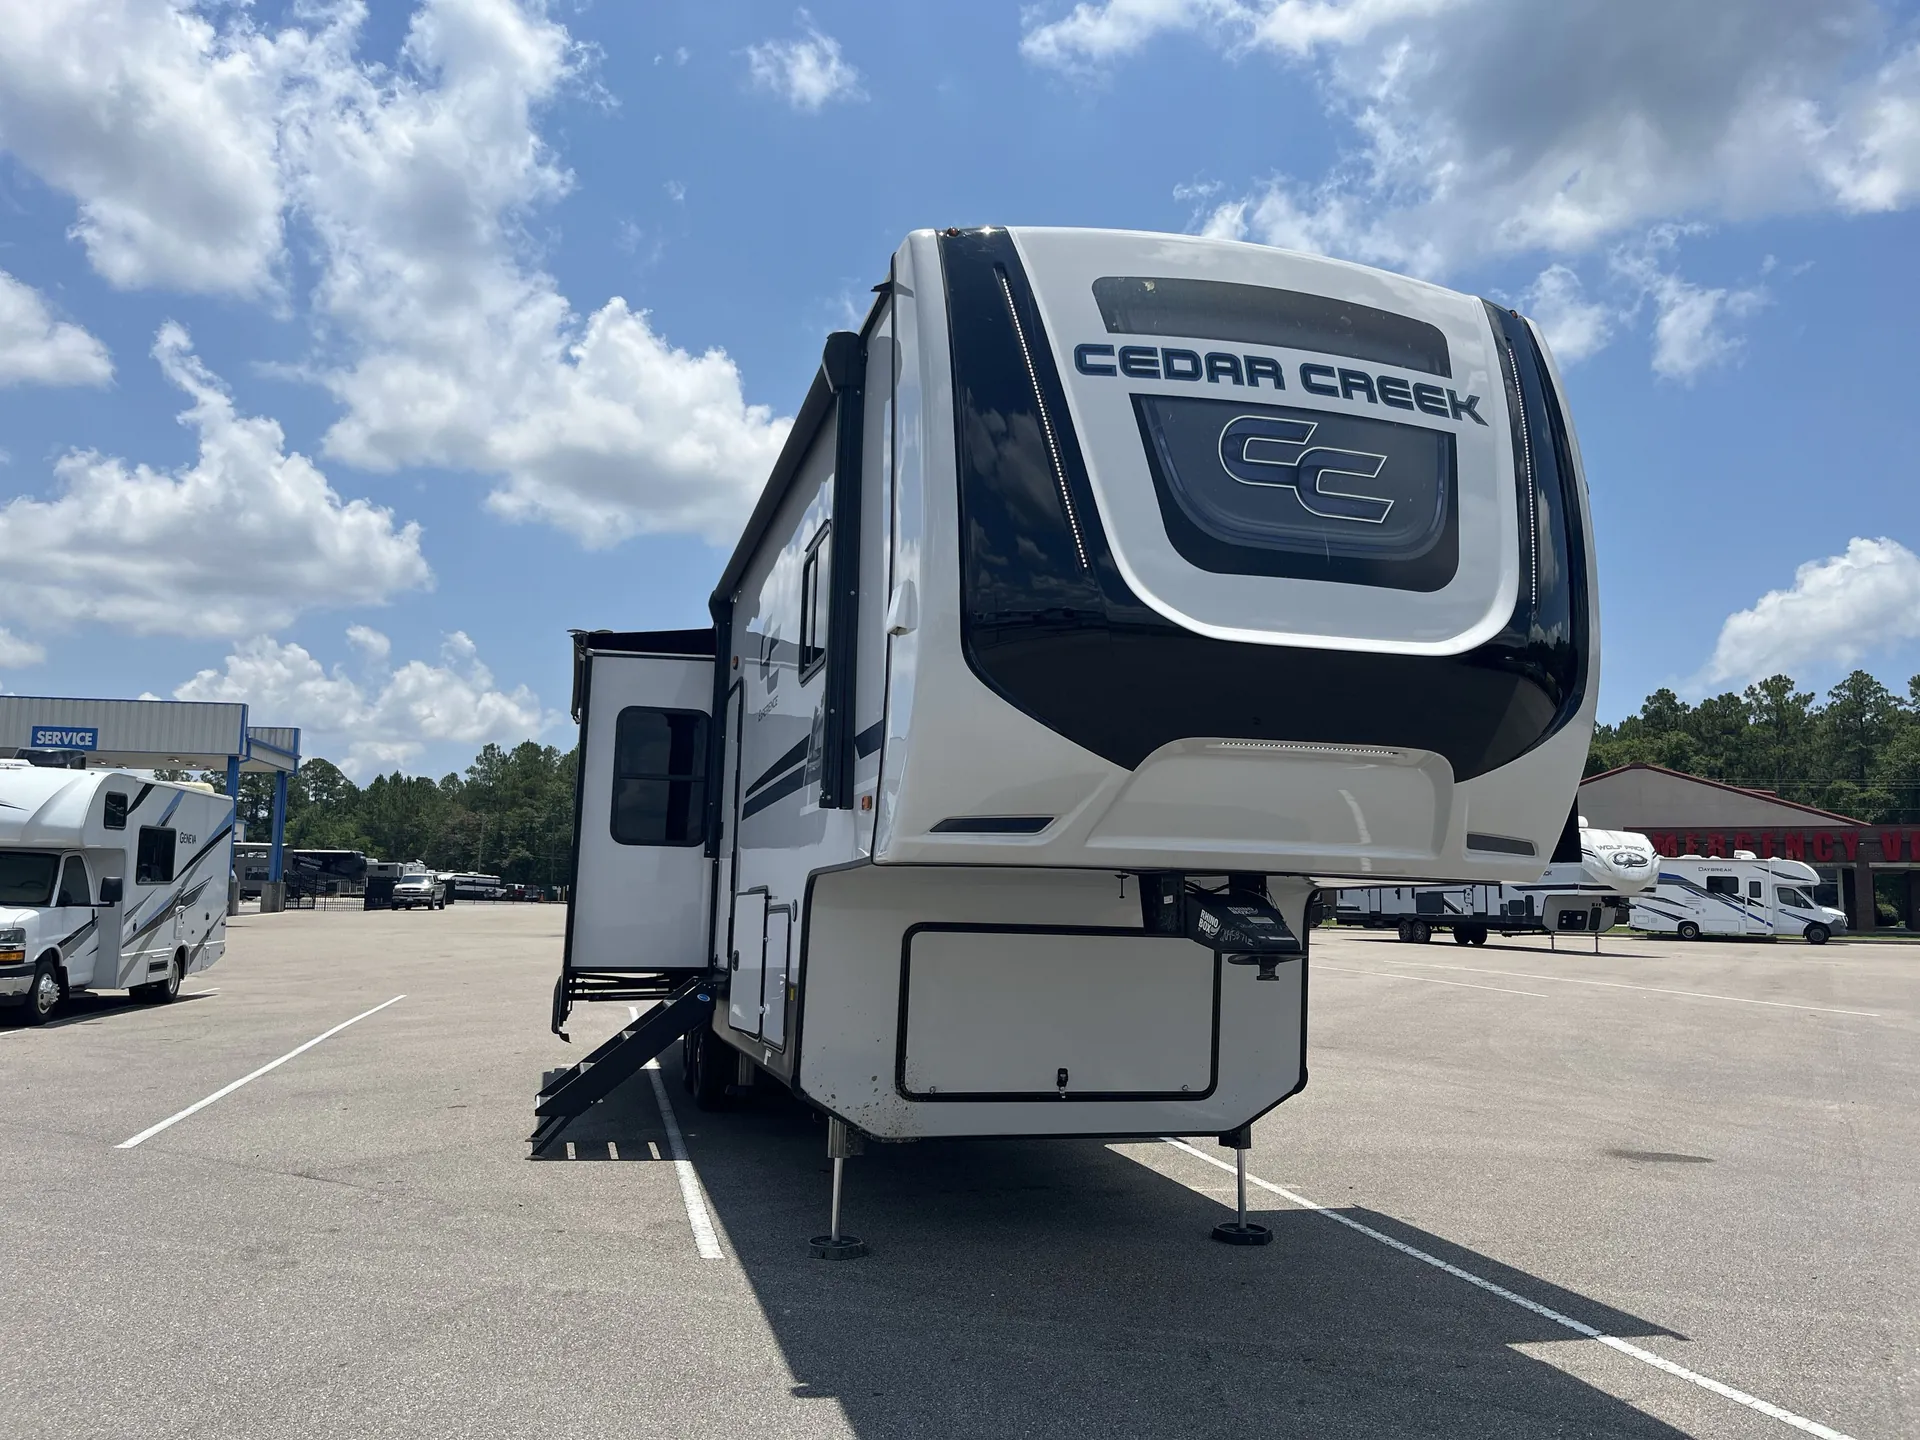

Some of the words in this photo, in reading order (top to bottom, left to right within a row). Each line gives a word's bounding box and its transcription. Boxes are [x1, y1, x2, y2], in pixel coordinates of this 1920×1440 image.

[1074, 343, 1286, 390] CEDAR
[1300, 362, 1488, 426] CREEK
[1218, 415, 1394, 523] CC
[36, 731, 93, 746] SERVICE
[1653, 832, 1859, 862] MERGENCY
[1199, 917, 1212, 934] BOX
[1201, 909, 1219, 928] RHINO
